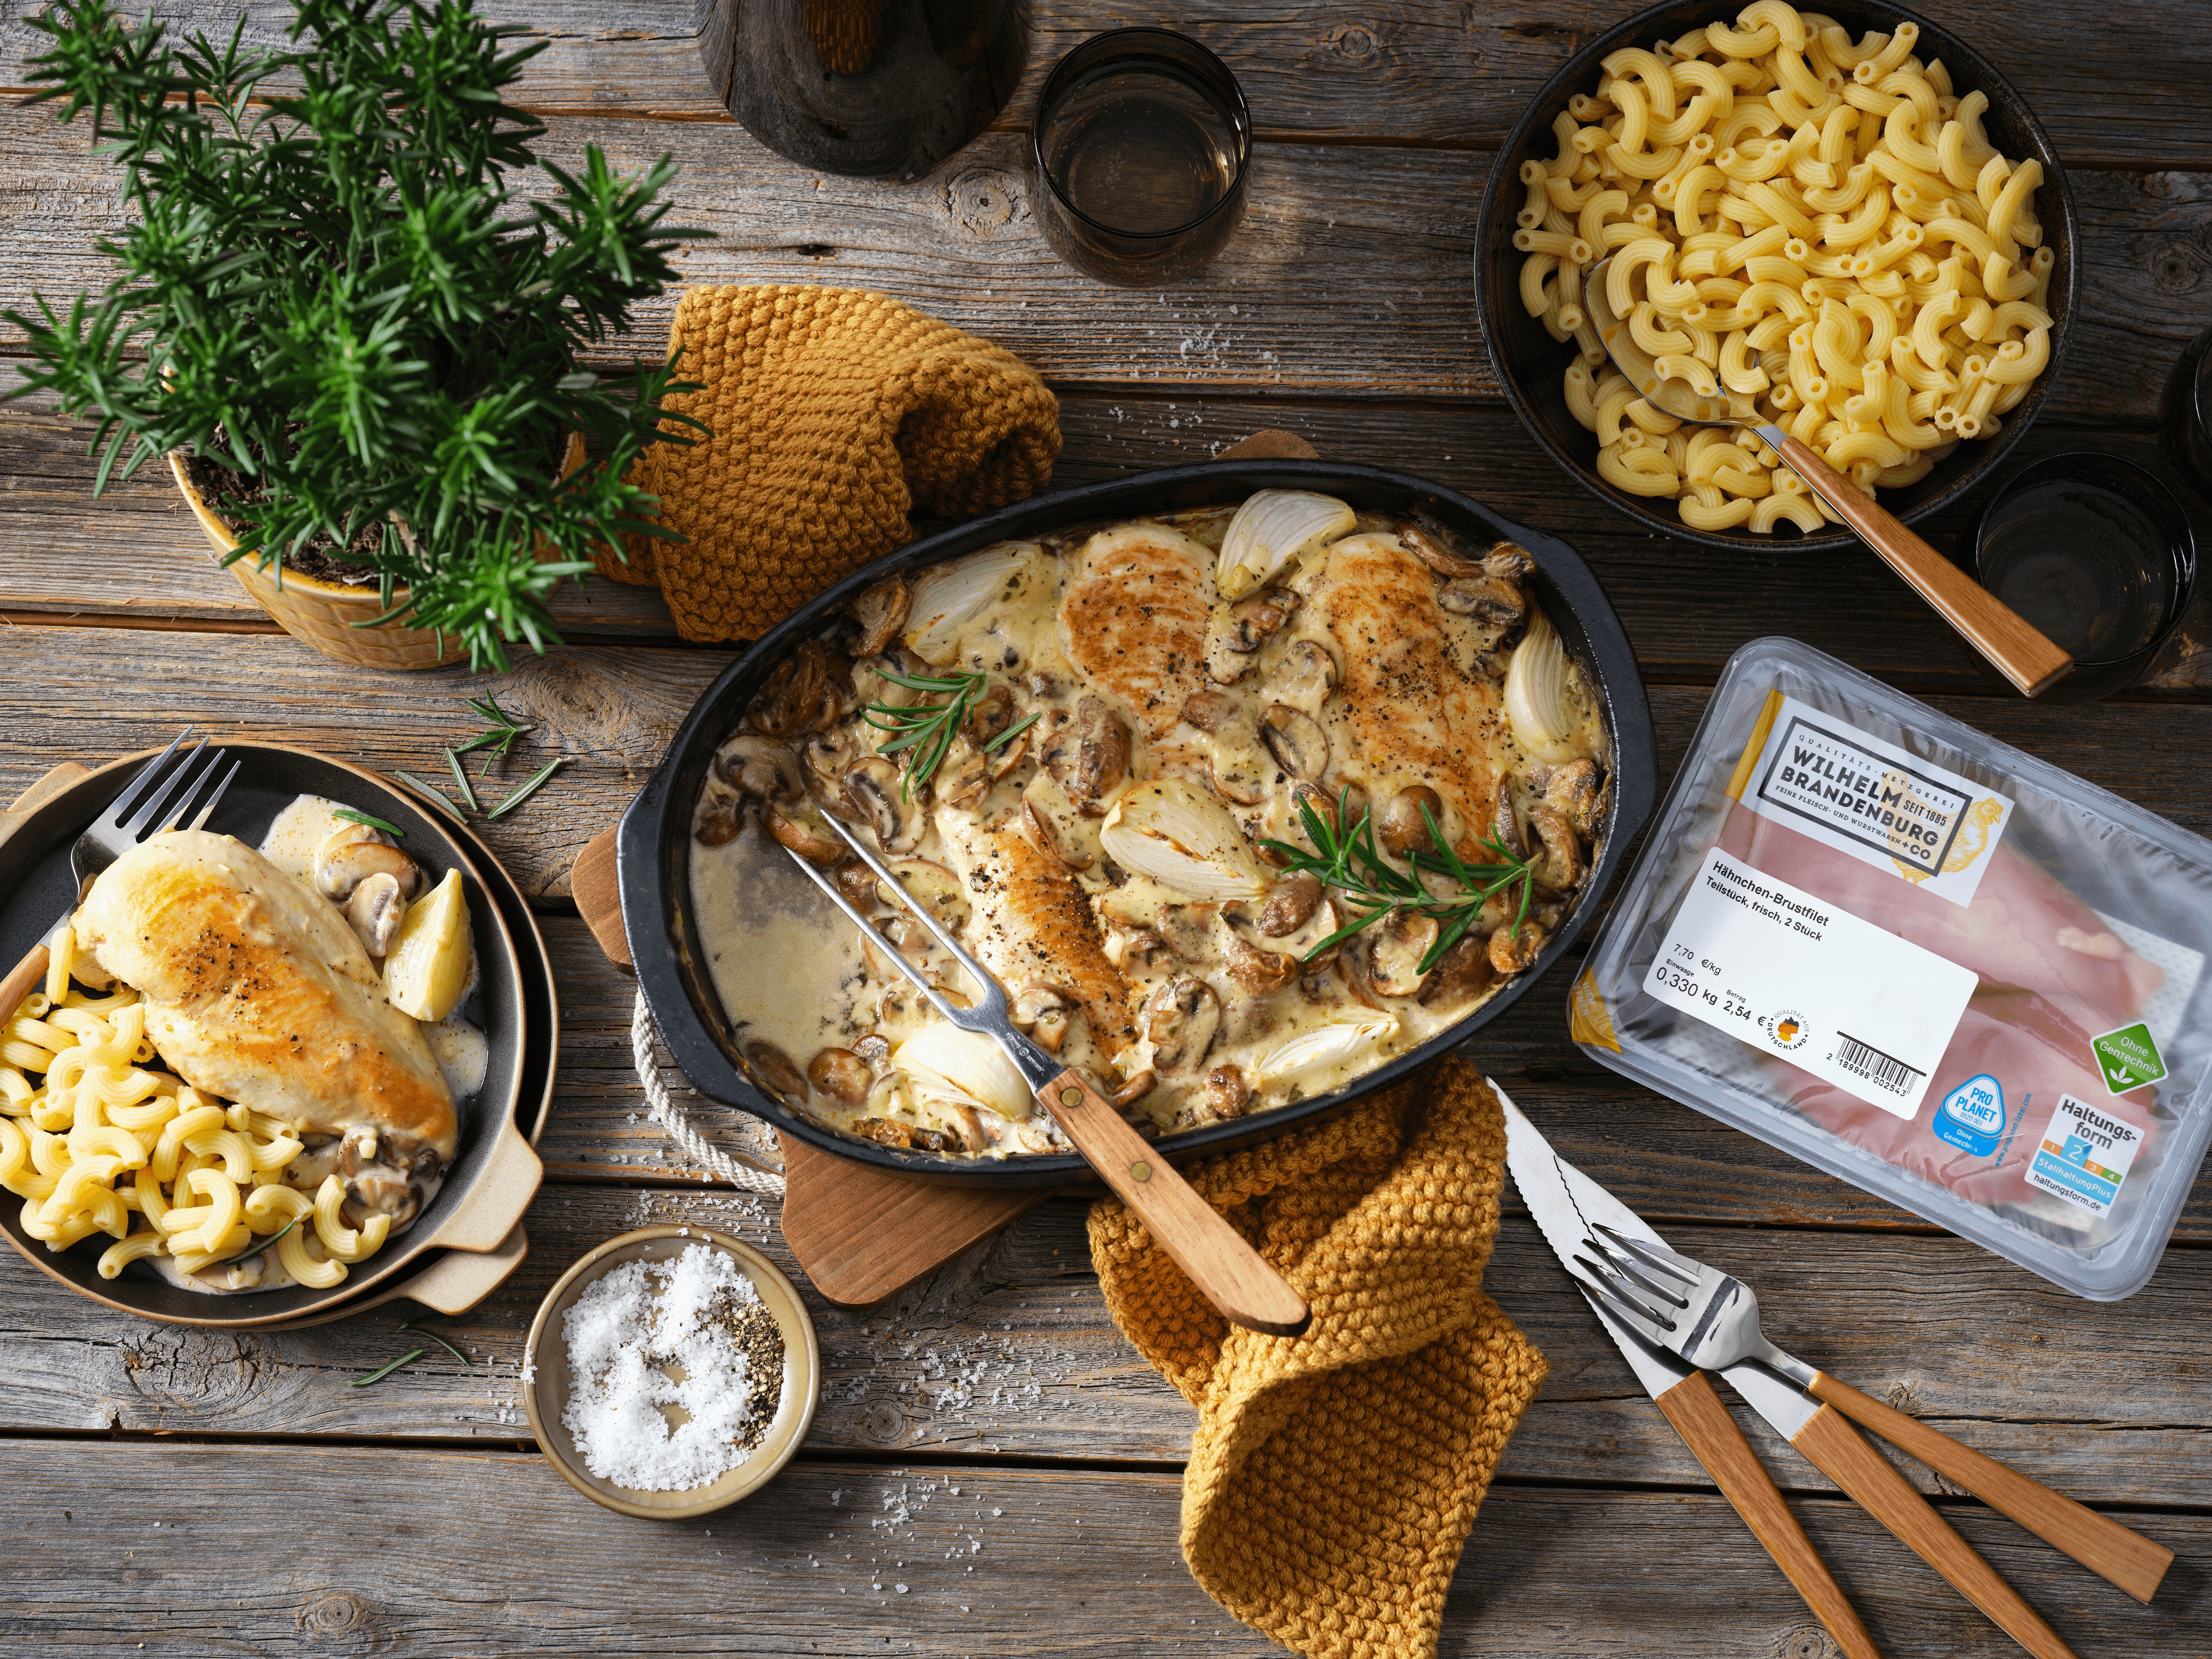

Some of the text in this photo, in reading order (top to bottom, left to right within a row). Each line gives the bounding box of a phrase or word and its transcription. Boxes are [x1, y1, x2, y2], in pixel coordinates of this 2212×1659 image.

[1793, 745, 1903, 808] WILHELM
[1799, 734, 1954, 809] QUALITÄTS-METZGEREI
[1775, 785, 1901, 845] FEINE FLEISCH- UND WURSTWAREN
[1780, 765, 1939, 846] BRANDENBURG
[1903, 800, 1947, 826] SEIT 1885
[1713, 861, 1829, 926] Hähnchen-Brustfilet
[1706, 876, 1823, 941] Teilstück, frisch, 2 Stück
[1666, 958, 1694, 977] Einwaage
[1674, 943, 1722, 976] 7,70 €/kg
[1582, 982, 1595, 1005] HIER
[1656, 967, 1718, 1006] 0,330 kg
[1726, 990, 1746, 1003] Betrag
[1723, 1000, 1767, 1026] 2,54 €
[1774, 1010, 1804, 1019] QUALITÄT
[1767, 1022, 1806, 1050] DEUTSCHLAND
[2120, 1037, 2149, 1056] Ohne
[1839, 1059, 1870, 1079] 189998
[1873, 1076, 1907, 1097] 002543
[1955, 1096, 1997, 1122] PLANET
[1970, 1087, 1993, 1106] PRO
[1960, 1111, 1983, 1126] 0520 001
[1994, 1093, 2032, 1167] www.proplanet-label.com
[2062, 1098, 2137, 1141] Haltungs-
[1943, 1132, 1978, 1153] Gentechnik
[1956, 1129, 1973, 1141] Ohne
[2074, 1121, 2113, 1149] form
[2068, 1144, 2082, 1161] 2
[2038, 1157, 2112, 1198] StallhaltungPlus
[2034, 1174, 2101, 1211] haltungsform.de
